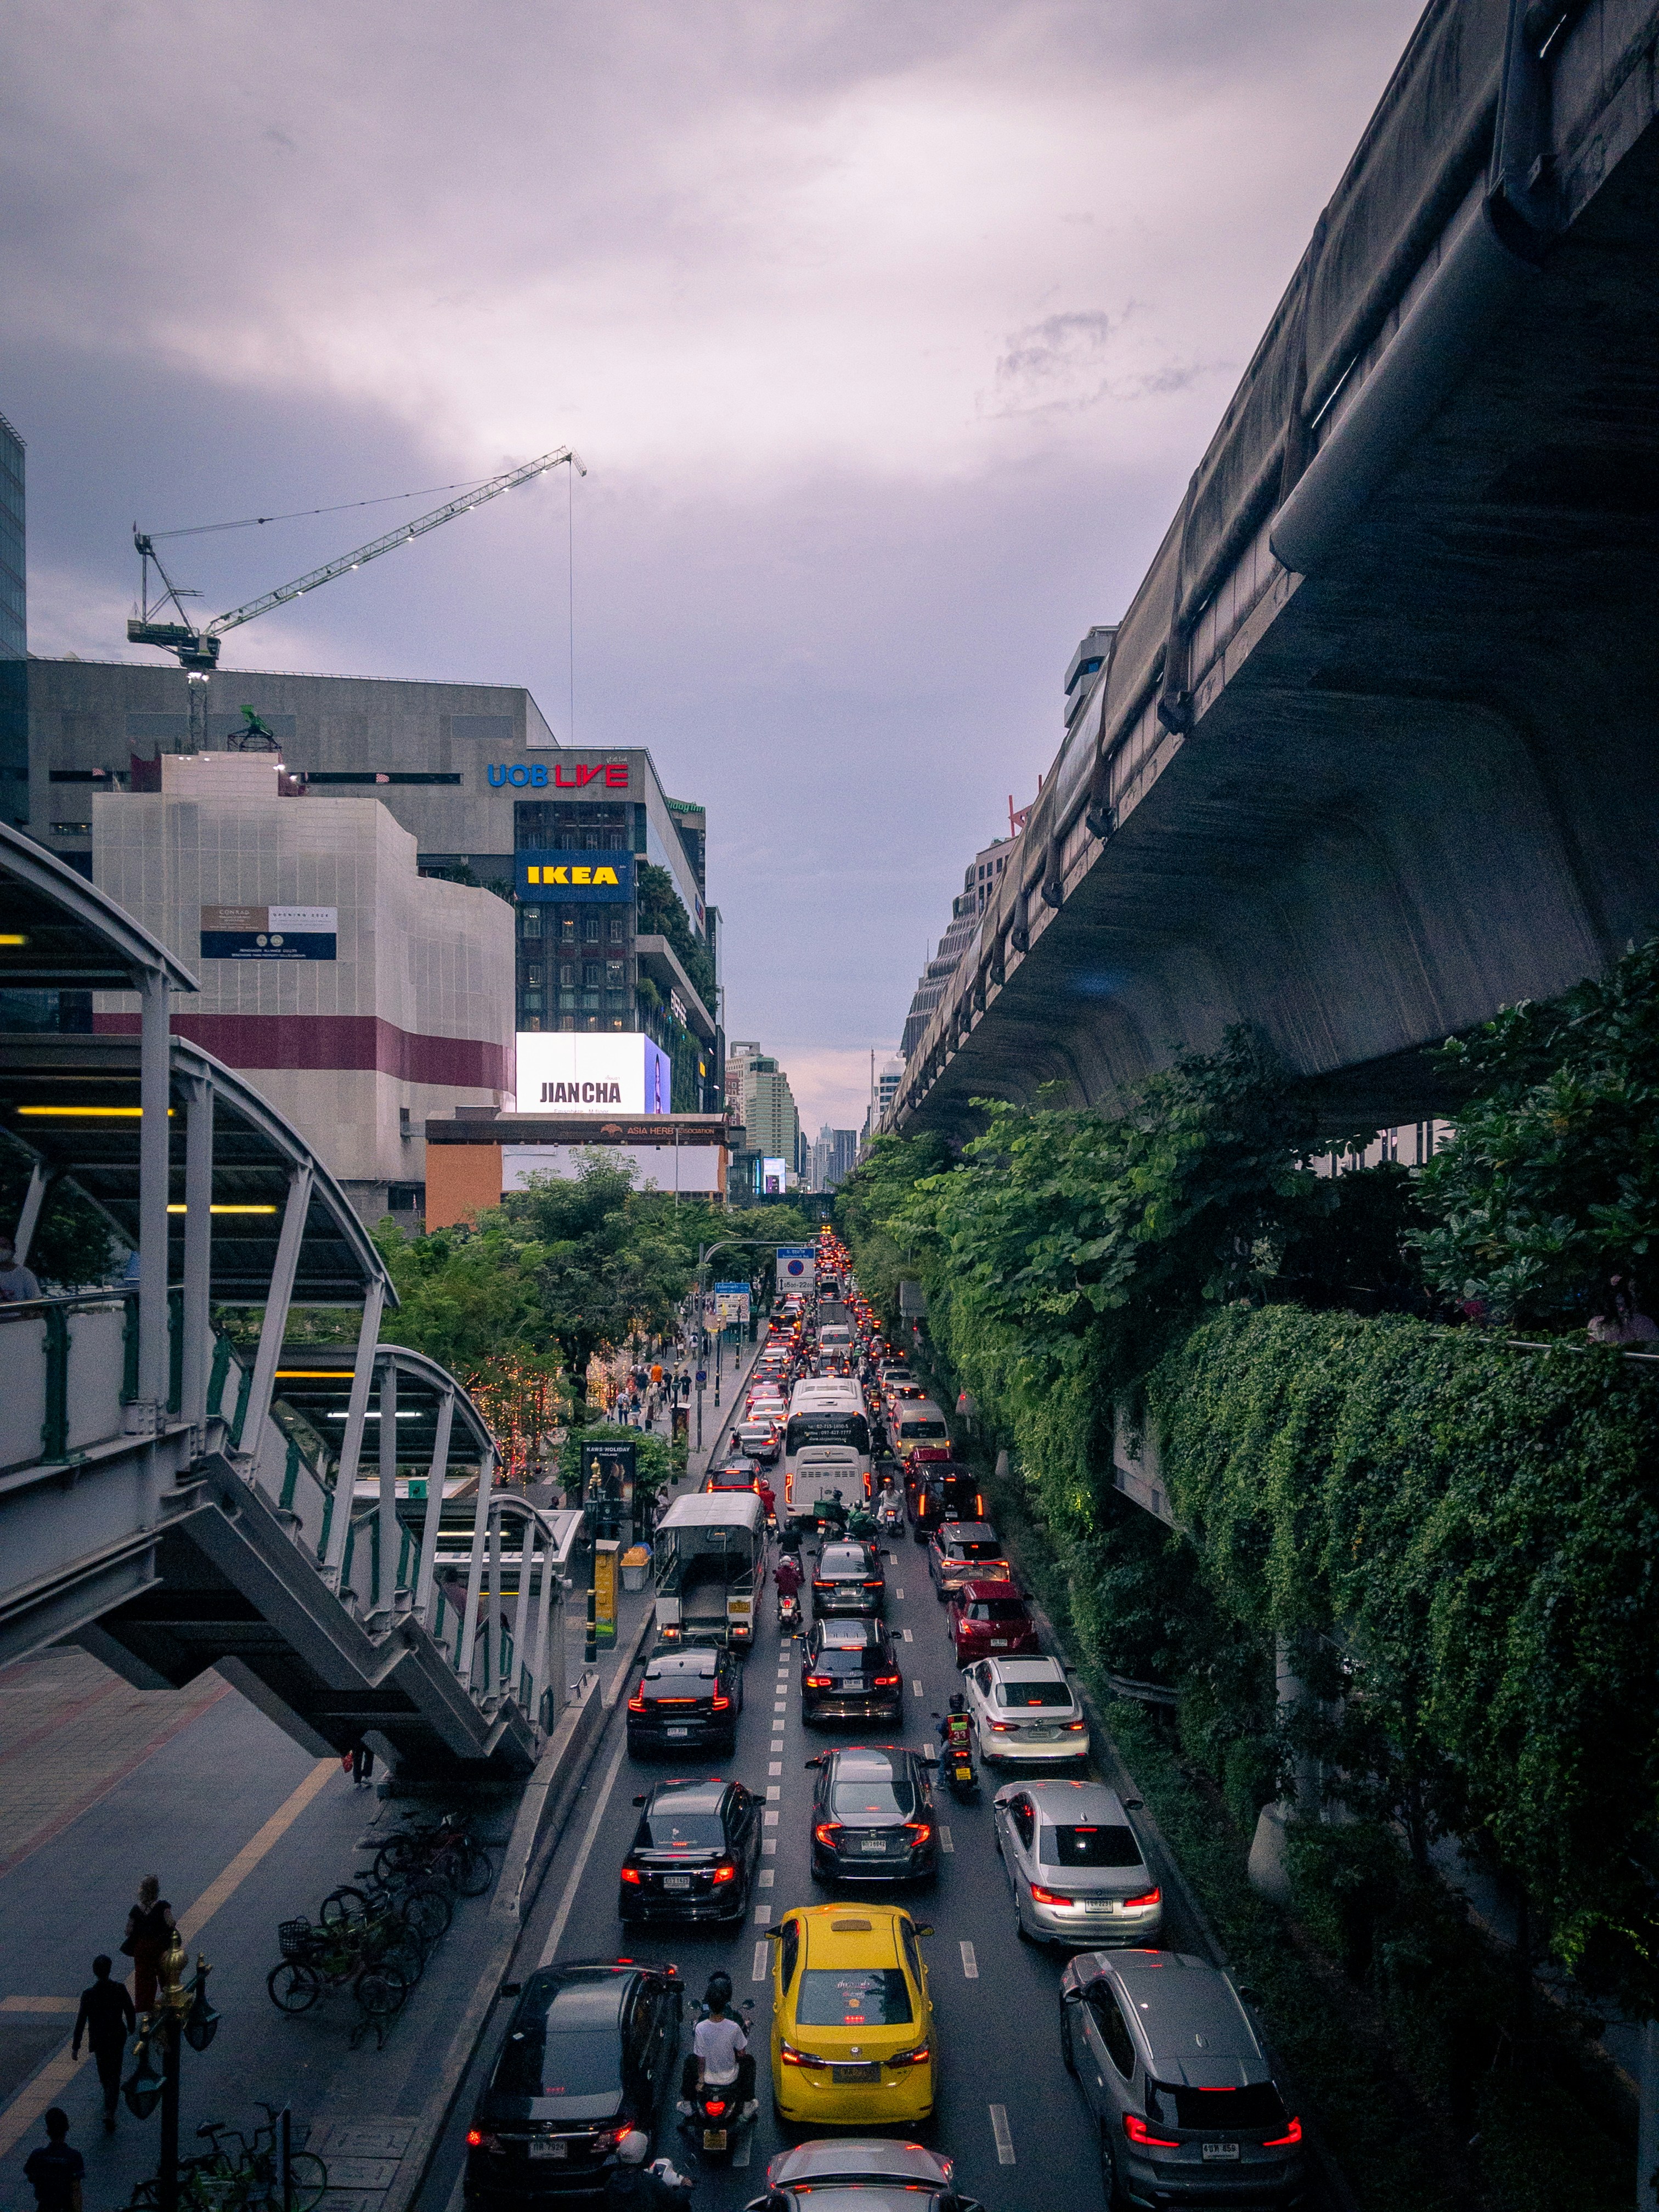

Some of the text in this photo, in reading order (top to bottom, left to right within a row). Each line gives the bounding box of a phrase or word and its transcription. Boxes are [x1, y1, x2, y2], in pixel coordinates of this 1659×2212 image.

[487, 764, 628, 787] UOB LIVE
[527, 866, 619, 884] IKEA
[953, 1730, 966, 1740] 33
